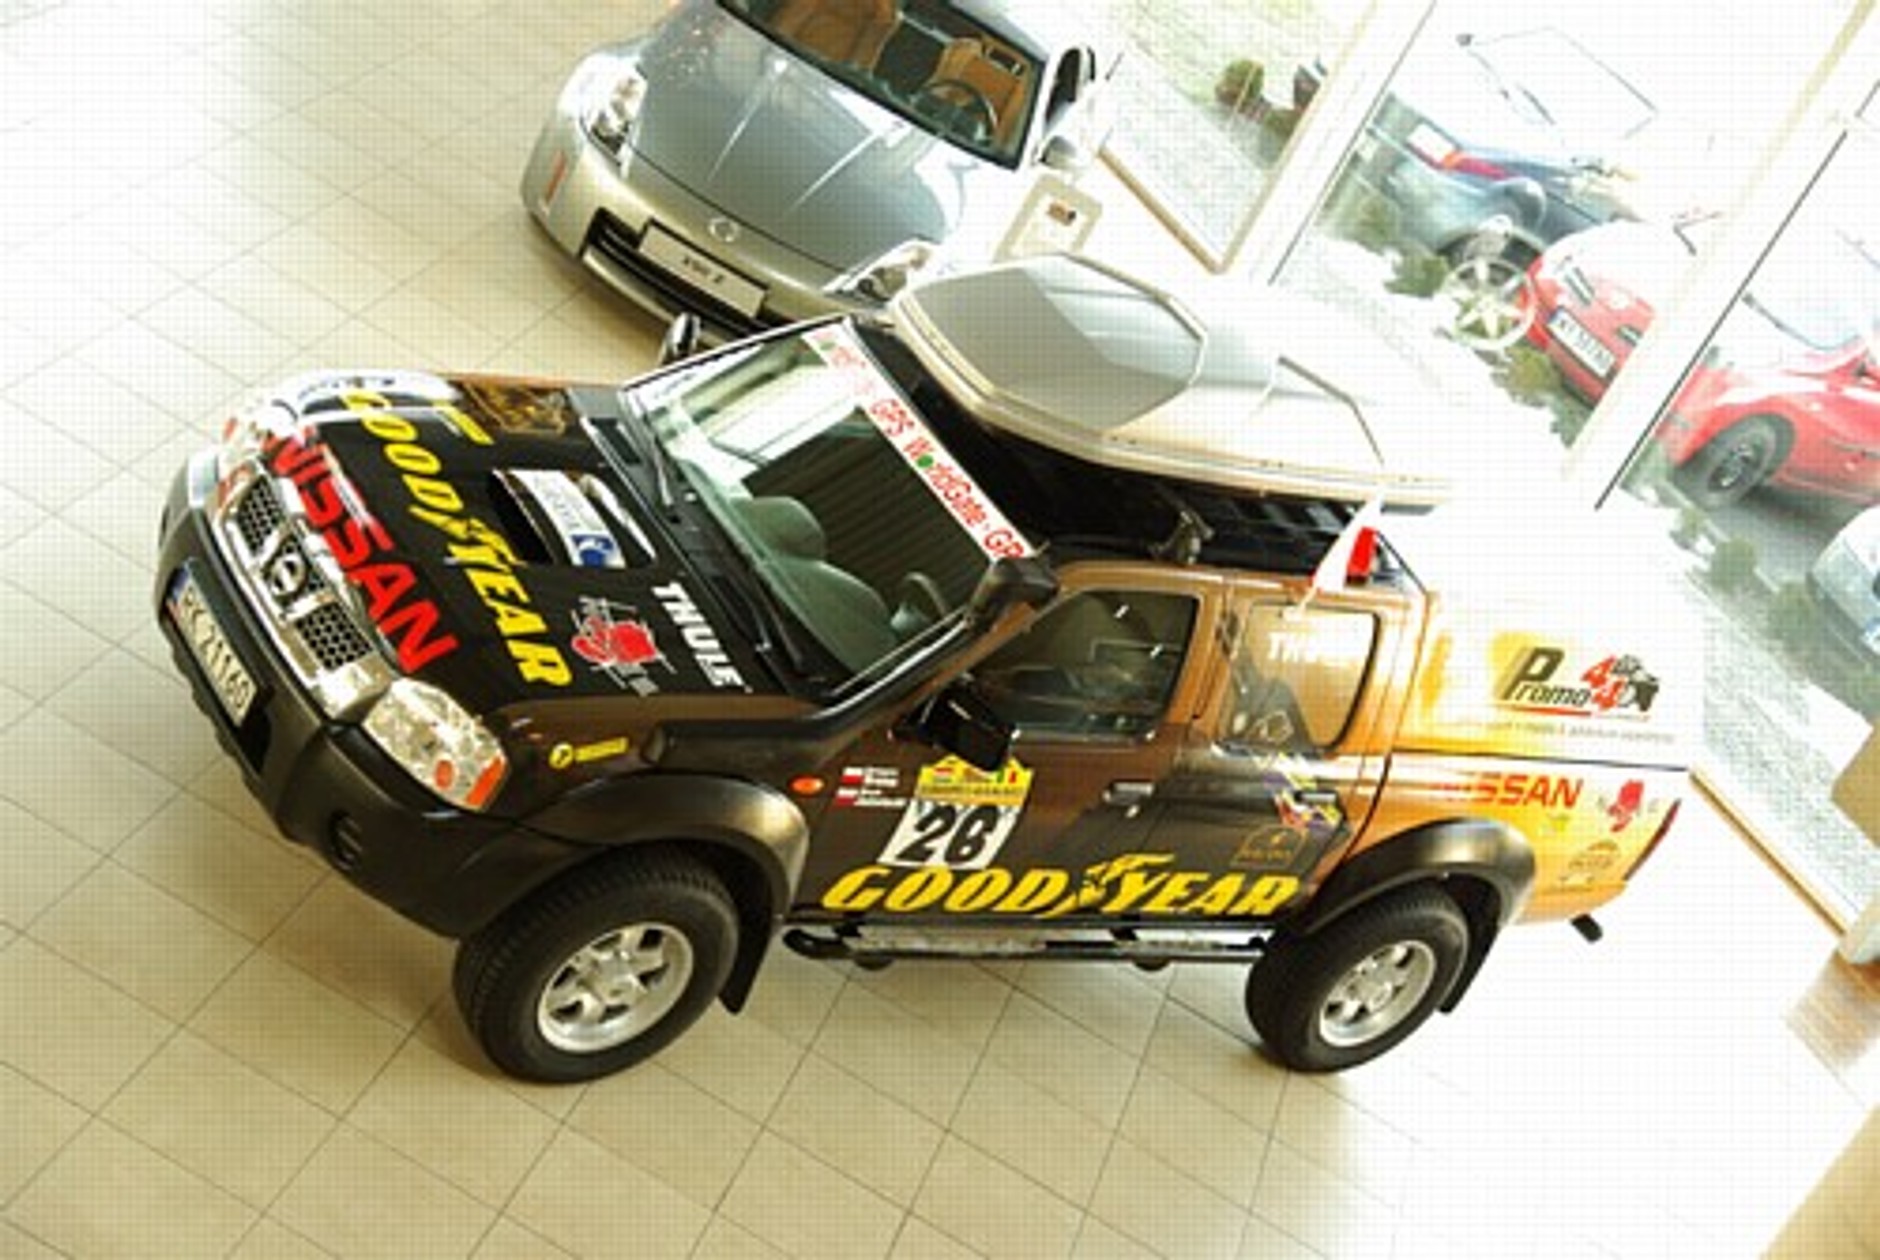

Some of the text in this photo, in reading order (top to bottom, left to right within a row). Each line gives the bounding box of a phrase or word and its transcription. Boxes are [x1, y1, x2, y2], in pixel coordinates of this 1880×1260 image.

[264, 425, 459, 674] NISSAN
[339, 390, 572, 687] GOODYEAR
[650, 580, 744, 692] THULE
[821, 856, 1300, 918] GOODYEAR
